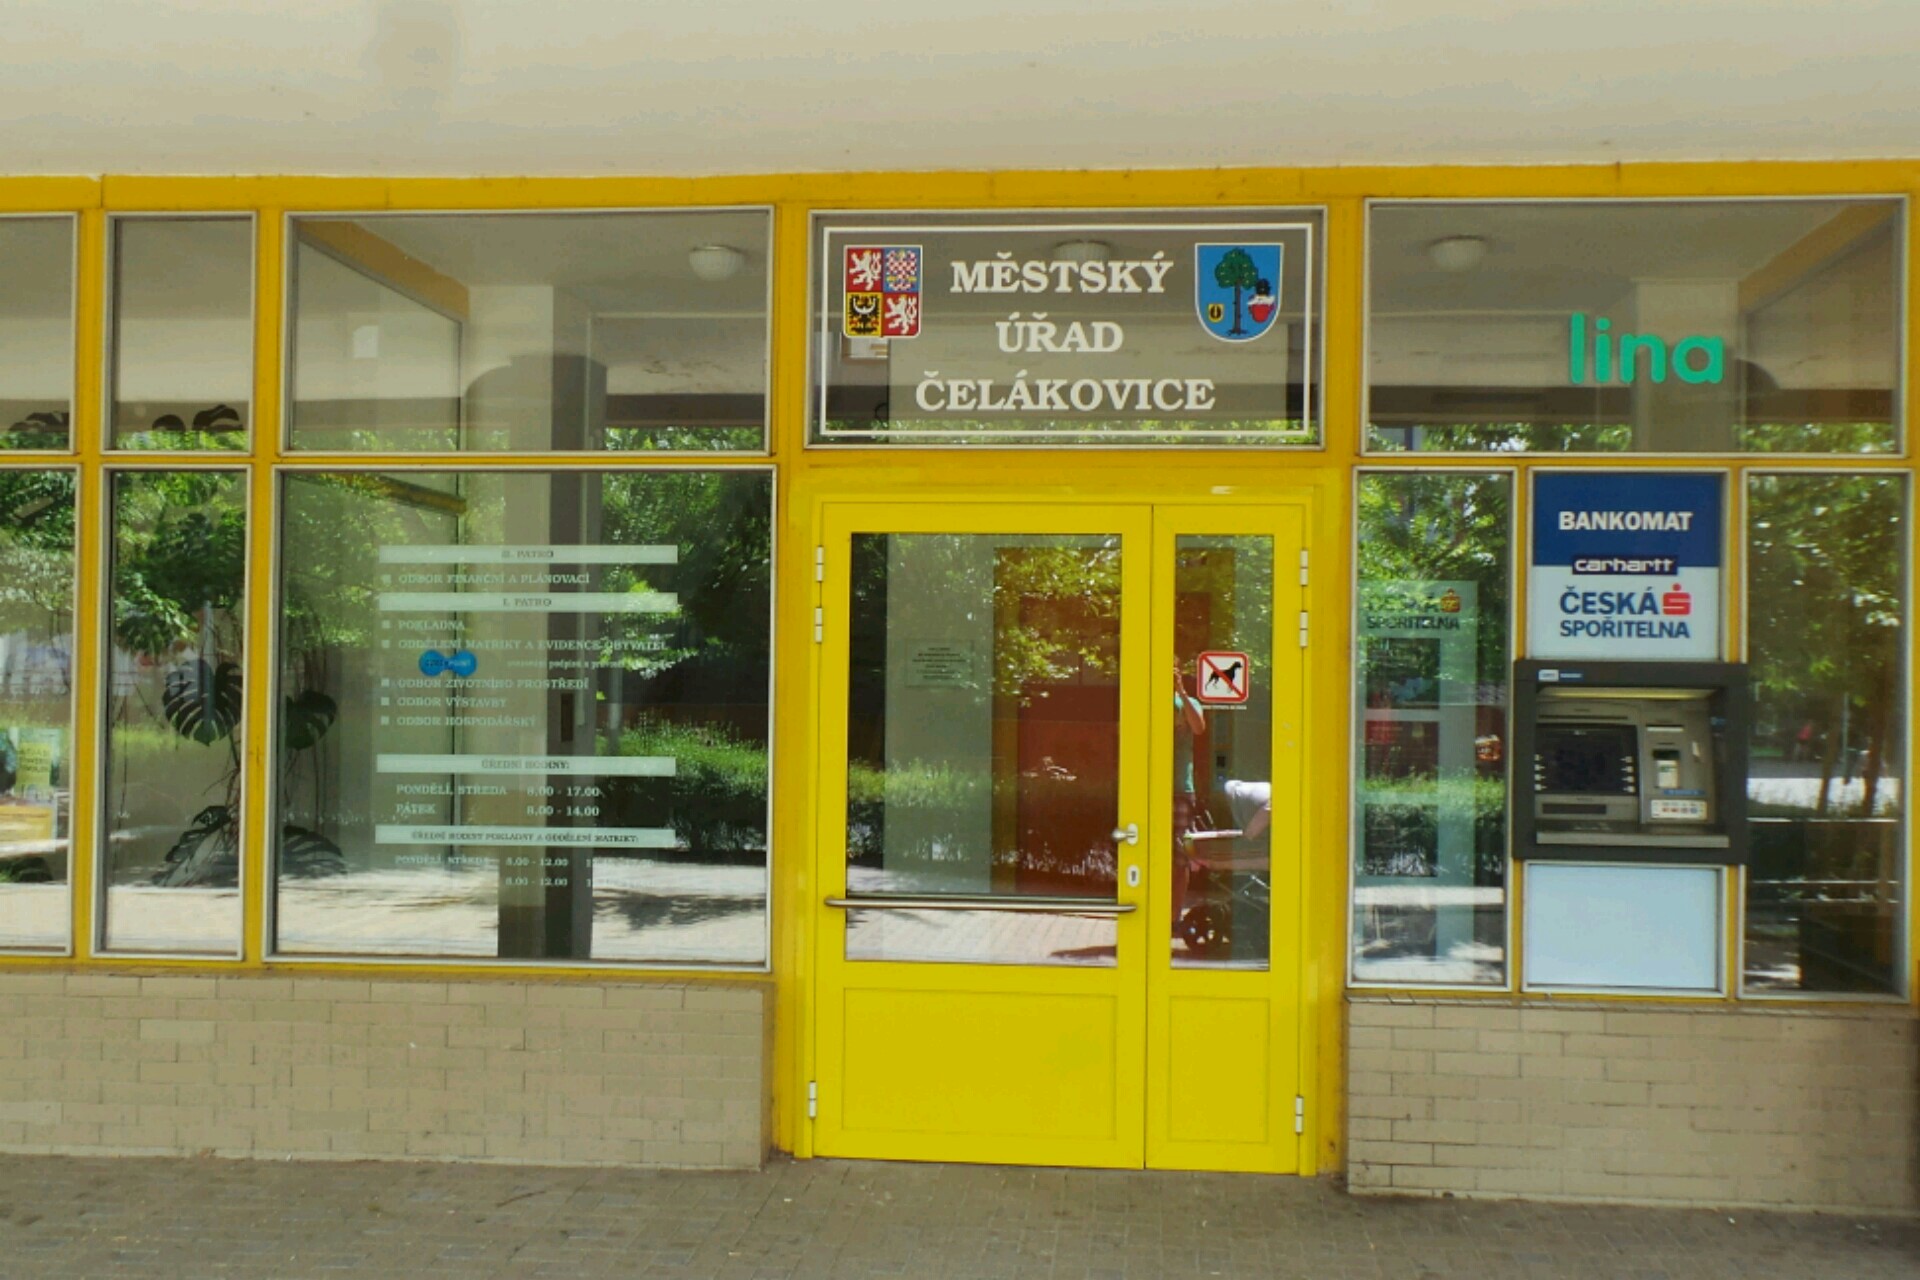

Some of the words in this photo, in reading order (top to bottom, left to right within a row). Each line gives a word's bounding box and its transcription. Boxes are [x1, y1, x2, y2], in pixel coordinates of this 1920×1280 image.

[950, 251, 1174, 293] MĚSTSKÝ
[995, 311, 1124, 352] ÚŘAD
[1571, 311, 1724, 385] lina
[915, 369, 1216, 411] ČELÁKOVICE
[1558, 511, 1694, 531] BANKOMAT
[1574, 558, 1675, 573] carhartt
[399, 574, 443, 584] ODBOR
[507, 574, 517, 584] A
[521, 571, 590, 584] PLÁNOVACÍ
[1559, 585, 1660, 615] ČESKÁ
[399, 619, 466, 630] POKLADNA
[1559, 616, 1690, 639] SPOŘITELNA
[465, 639, 521, 649] MATRIKY
[525, 640, 534, 649] A
[538, 640, 600, 650] EVIDENCE
[398, 679, 442, 689] ODBOR
[517, 677, 589, 690] PROSTŘEDÍ
[397, 697, 441, 707] ODBOR
[446, 694, 506, 708] VÝSTAVBY
[397, 716, 441, 726] ODBOR
[396, 801, 436, 814] PÁTEK
